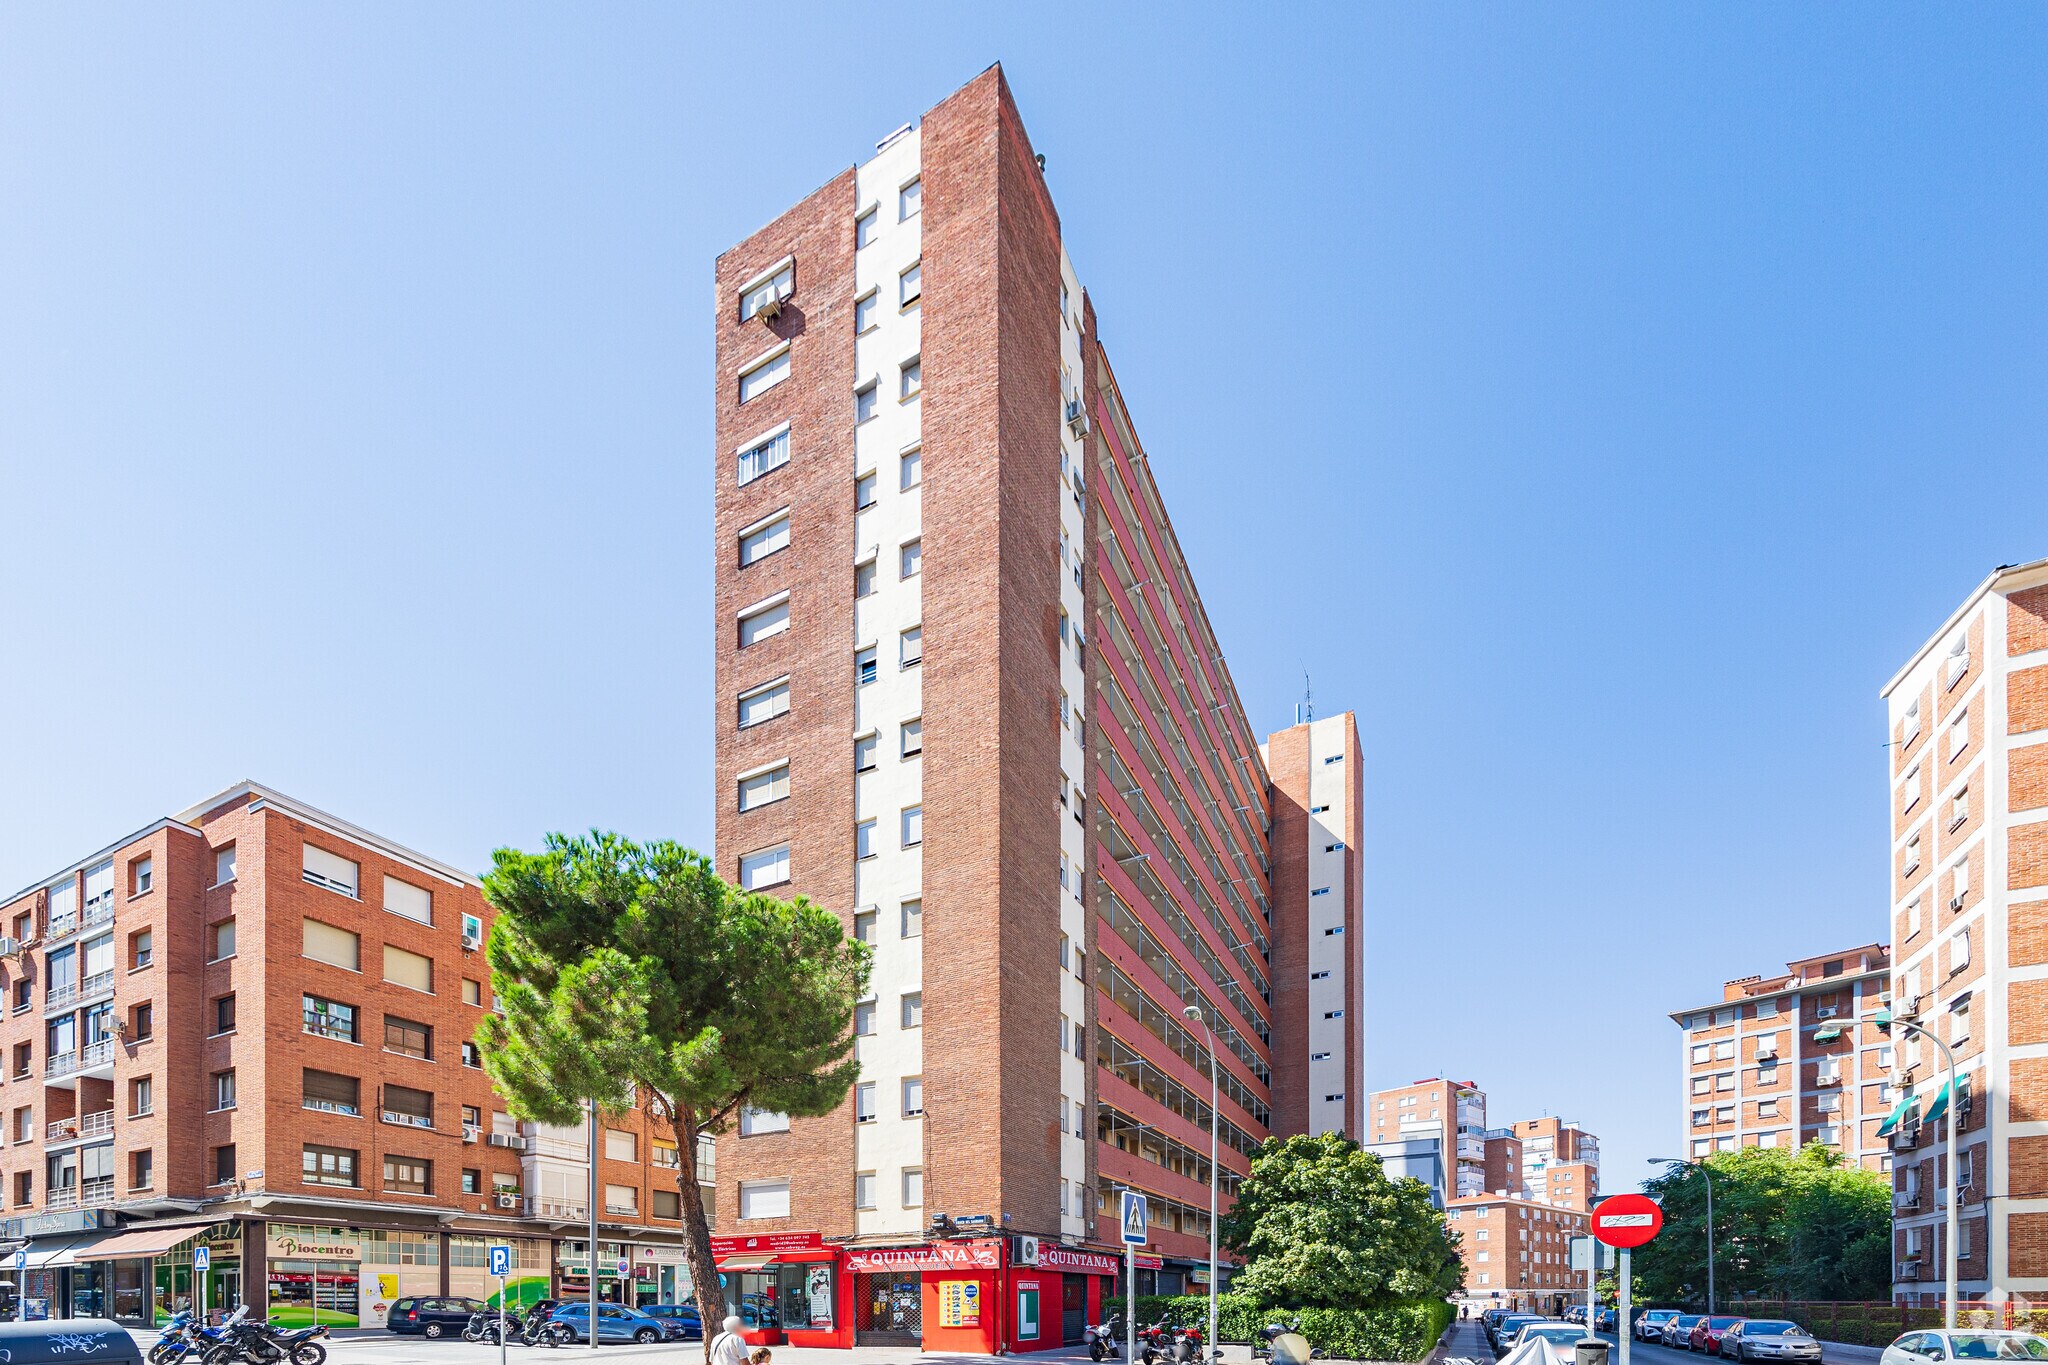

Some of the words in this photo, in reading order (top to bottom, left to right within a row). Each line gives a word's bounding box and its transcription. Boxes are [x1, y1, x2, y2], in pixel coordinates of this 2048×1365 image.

[277, 1237, 354, 1256] Biocentro
[18, 1253, 24, 1267] P
[494, 1250, 506, 1273] P
[871, 1249, 969, 1266] QUINTANA
[1049, 1251, 1109, 1268] QUINTANA
[883, 1262, 955, 1271] AUTOESCUELA
[1020, 1293, 1037, 1335] L
